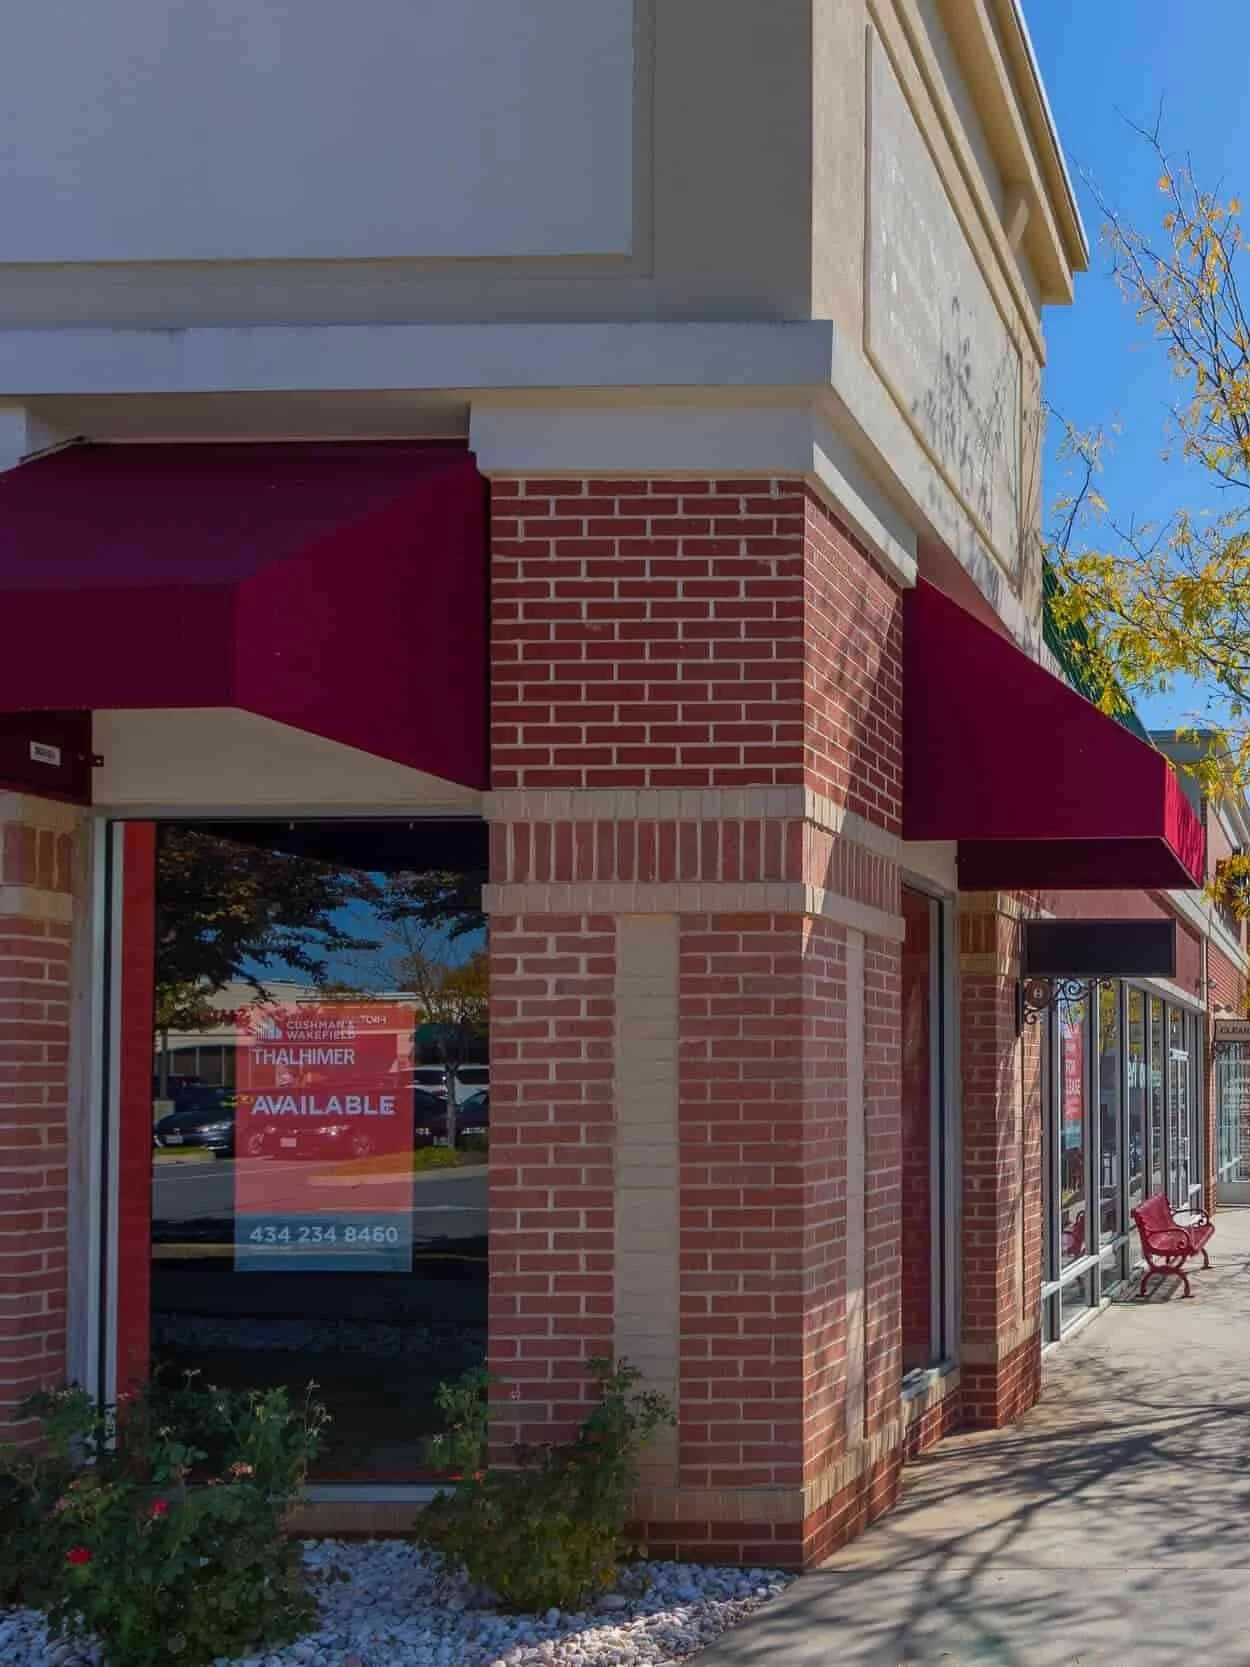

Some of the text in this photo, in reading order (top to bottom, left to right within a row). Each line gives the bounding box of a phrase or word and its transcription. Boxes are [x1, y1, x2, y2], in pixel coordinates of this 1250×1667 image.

[287, 1030, 356, 1041] WAKEFIELD
[253, 1048, 356, 1065] THALHIMER
[251, 1095, 395, 1115] AVAILABLE
[250, 1226, 400, 1243] 434 234 8460
